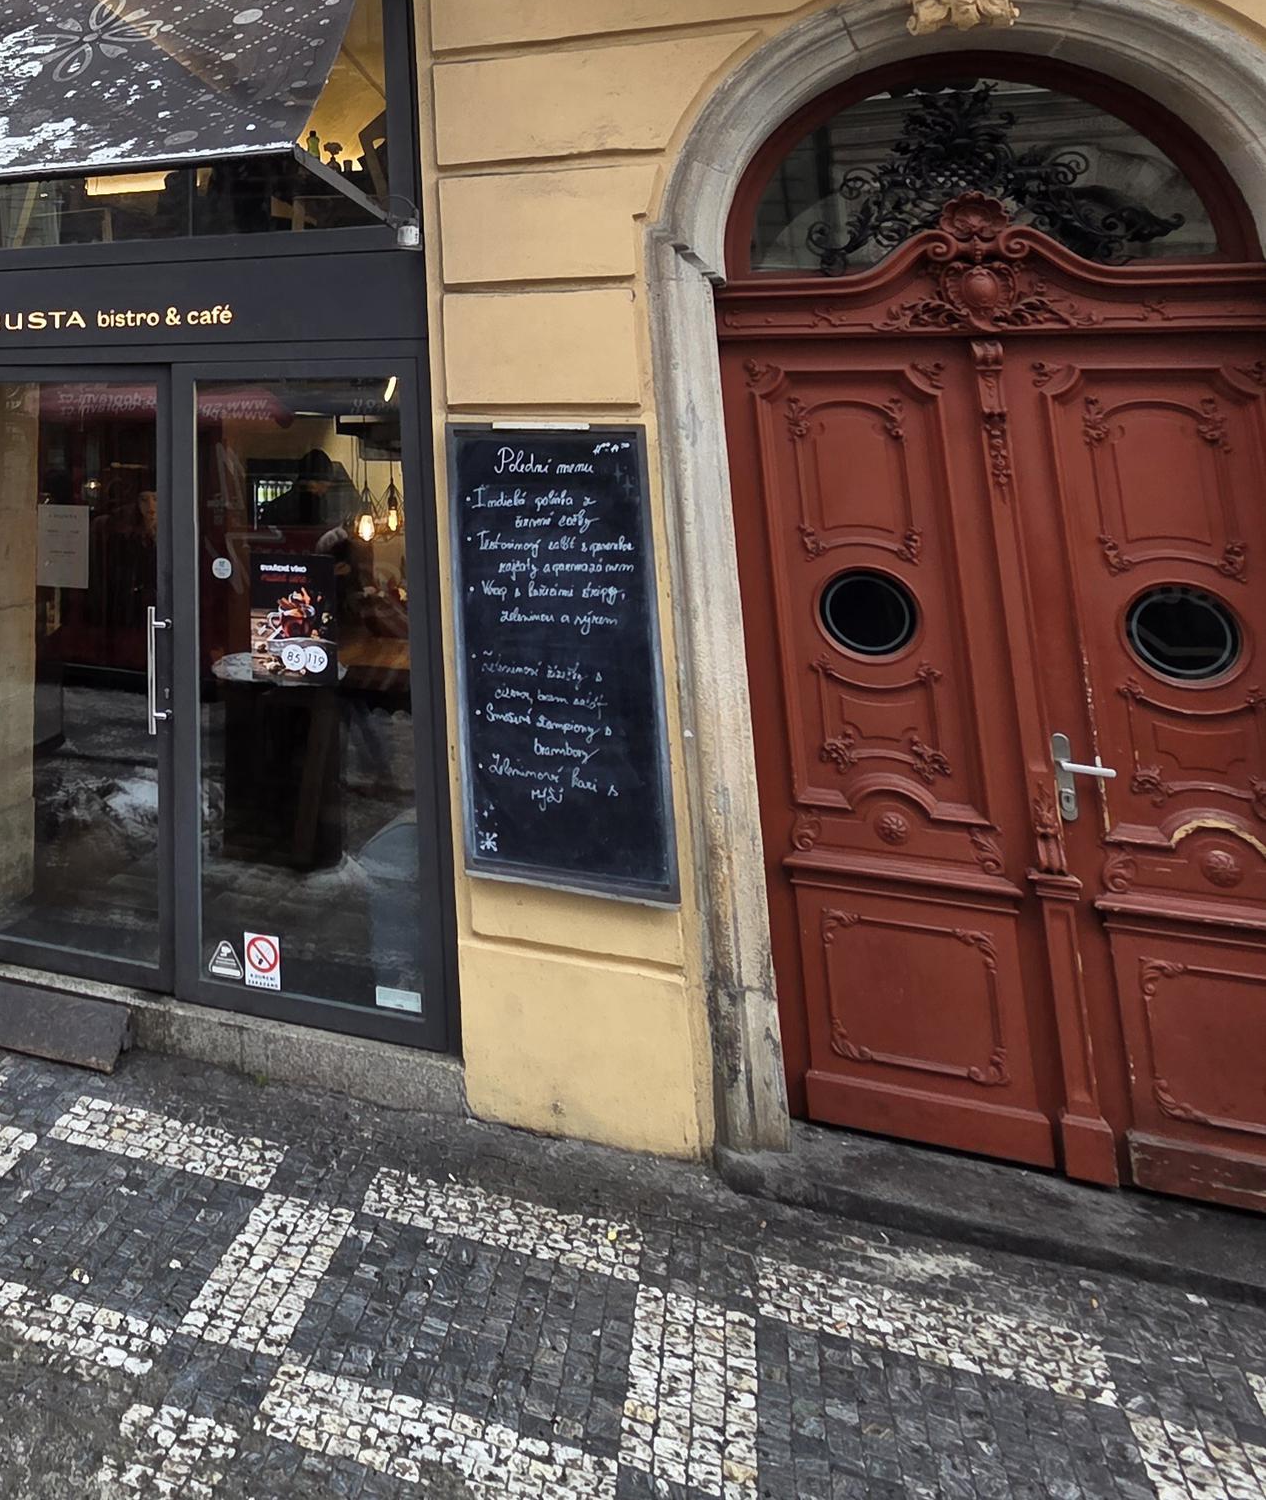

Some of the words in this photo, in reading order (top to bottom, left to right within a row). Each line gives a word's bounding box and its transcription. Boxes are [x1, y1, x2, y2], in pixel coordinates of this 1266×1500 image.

[97, 310, 159, 328] bistro
[165, 306, 182, 327] &
[187, 304, 233, 325] café
[494, 446, 553, 474] Polední
[555, 462, 594, 474] menu
[481, 580, 508, 601] Wrap
[560, 614, 571, 623] a
[286, 650, 301, 663] 85
[307, 653, 326, 666] 119
